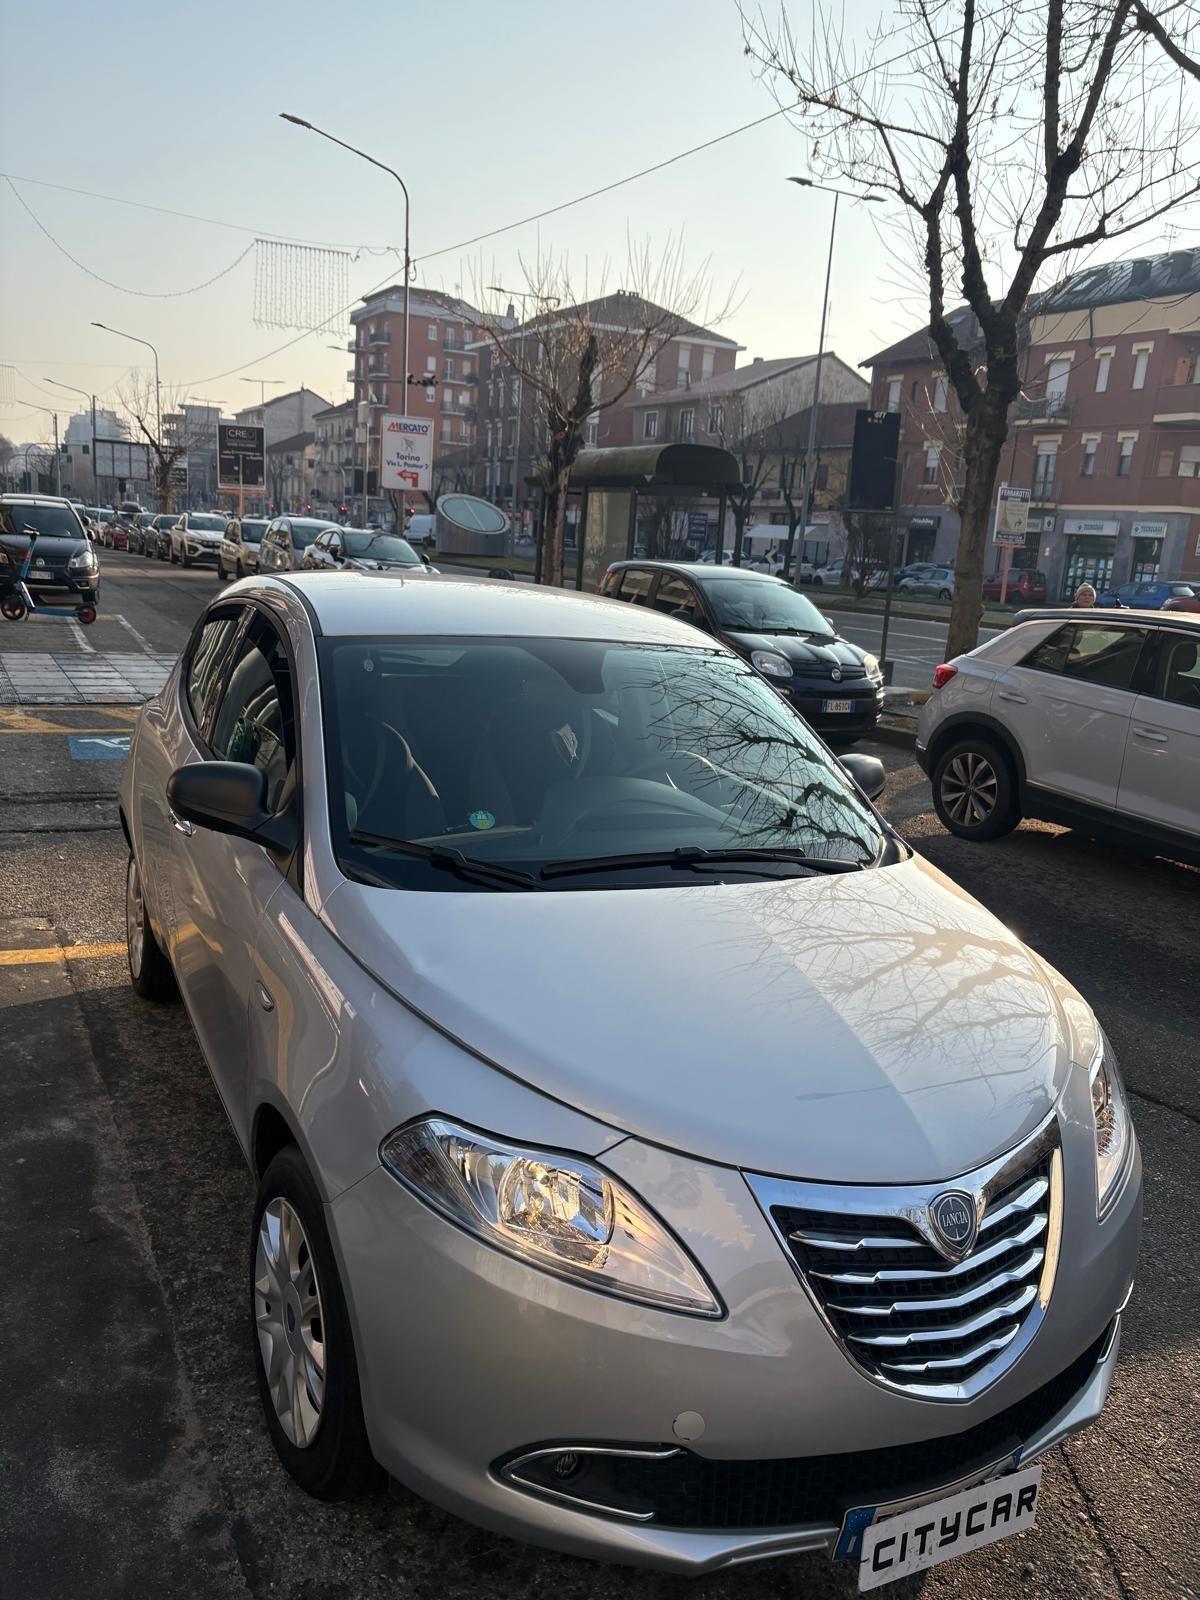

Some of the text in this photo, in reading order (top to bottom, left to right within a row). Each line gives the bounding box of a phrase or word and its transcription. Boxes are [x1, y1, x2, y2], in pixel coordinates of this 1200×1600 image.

[396, 452, 421, 462] Torino
[1001, 488, 1031, 498] FERRAROTTI
[941, 1211, 969, 1228] LANCIA
[872, 1483, 1038, 1573] CITYCAR
